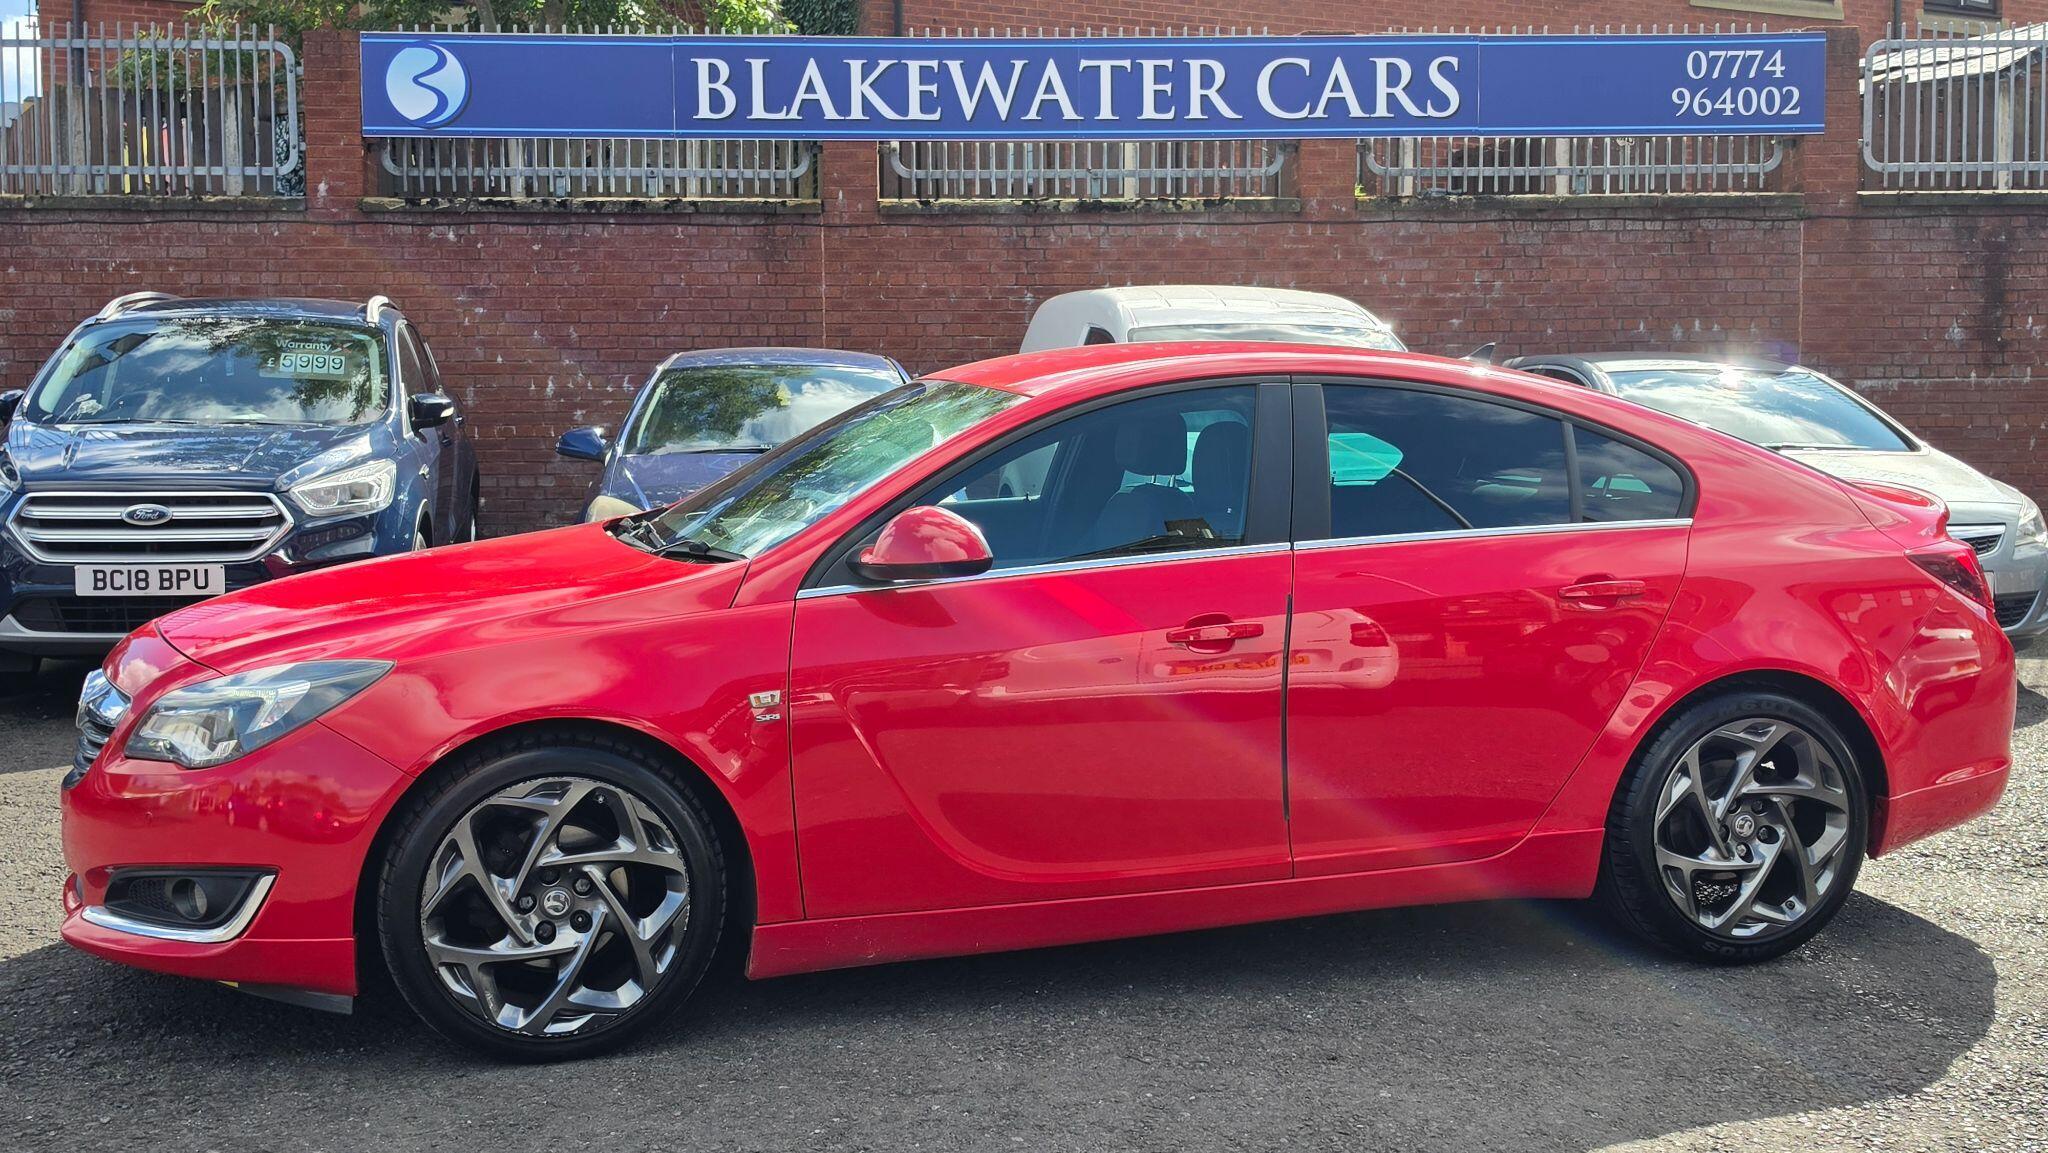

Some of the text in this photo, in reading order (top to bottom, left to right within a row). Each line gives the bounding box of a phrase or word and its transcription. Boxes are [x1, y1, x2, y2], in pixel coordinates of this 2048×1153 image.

[1686, 49, 1786, 80] 07774
[690, 56, 1461, 122] BLAKEWATER CARS
[1671, 86, 1801, 117] 964002
[275, 339, 332, 352] Warranty
[133, 508, 160, 520] Ford
[92, 568, 210, 591] BC18 BPU
